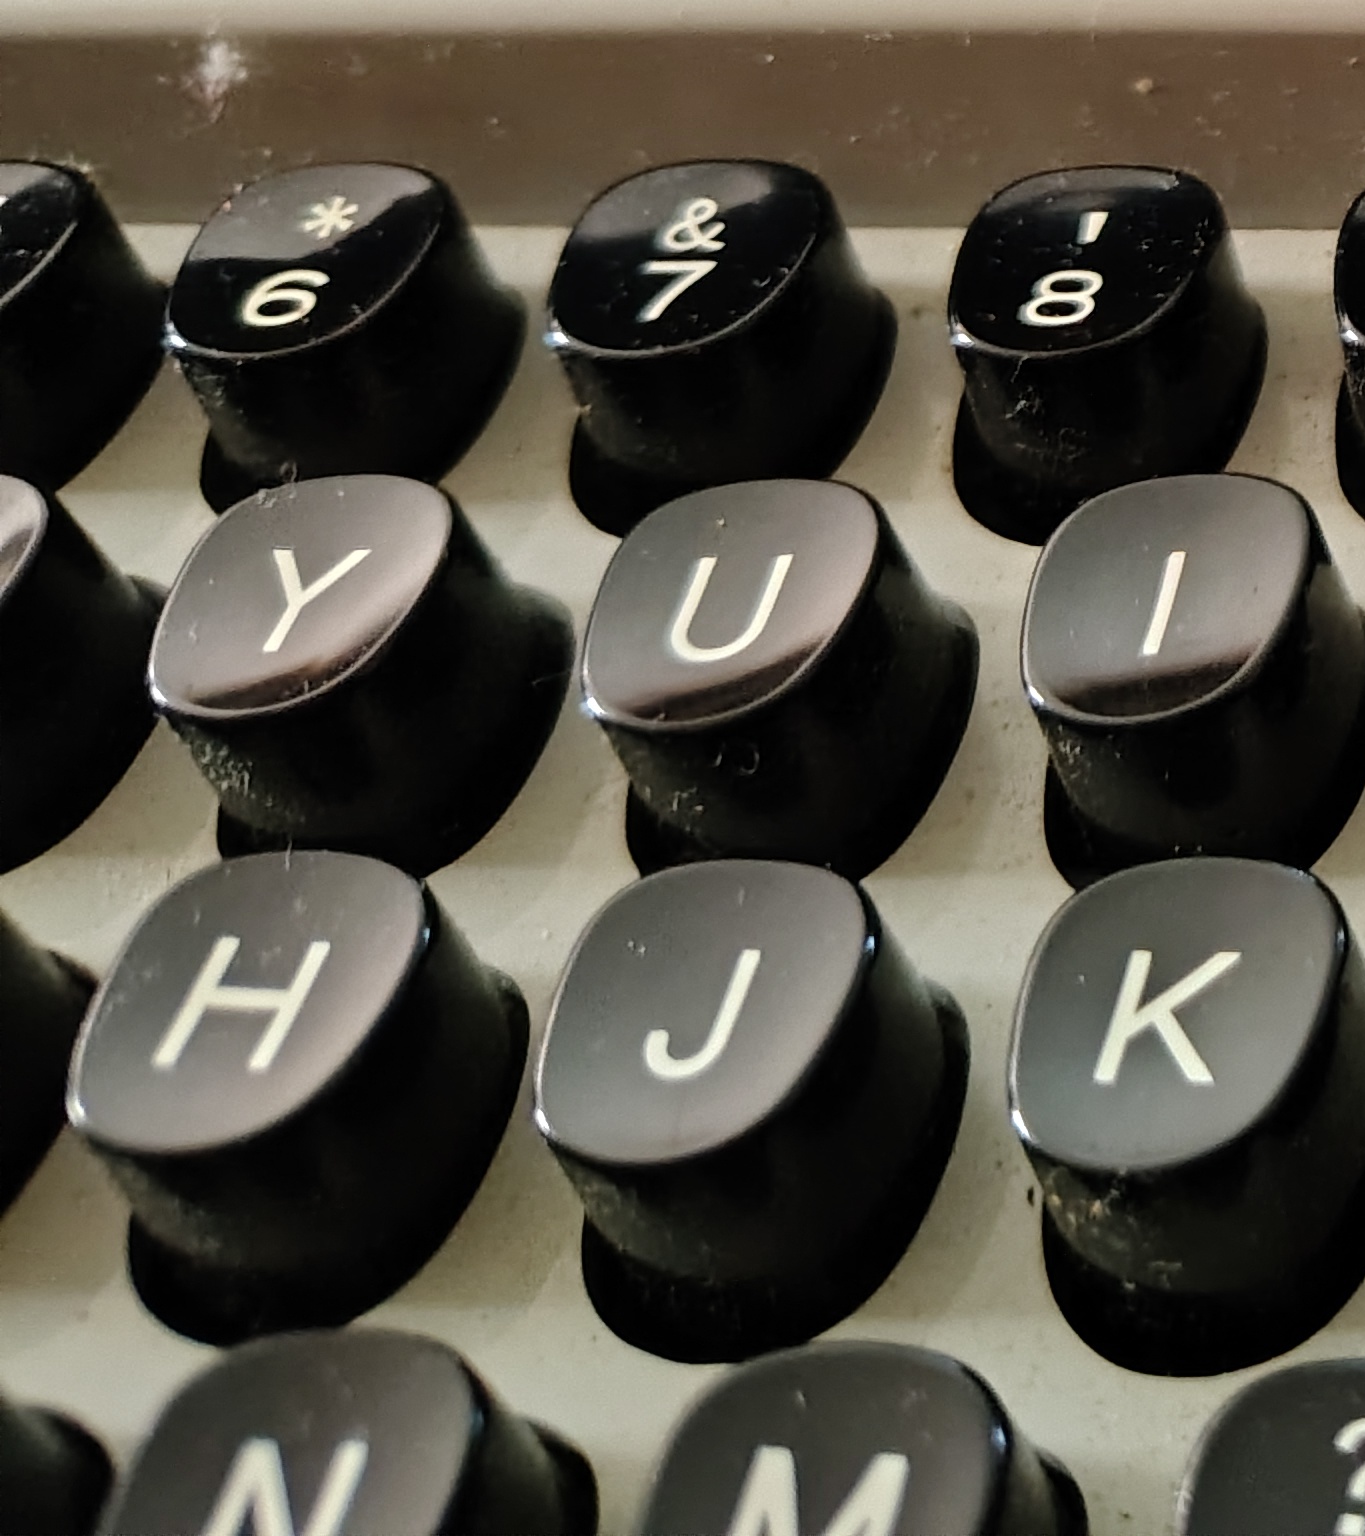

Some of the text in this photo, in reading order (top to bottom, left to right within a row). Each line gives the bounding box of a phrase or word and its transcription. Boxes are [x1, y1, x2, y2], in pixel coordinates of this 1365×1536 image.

[660, 196, 726, 252] &
[241, 268, 330, 328] 6
[642, 259, 718, 322] 7
[1020, 268, 1104, 327] 8
[261, 547, 373, 654] Y
[668, 552, 795, 664] U
[1141, 550, 1187, 658] I
[152, 935, 333, 1072] H
[642, 948, 762, 1082] J
[1092, 949, 1242, 1087] K
